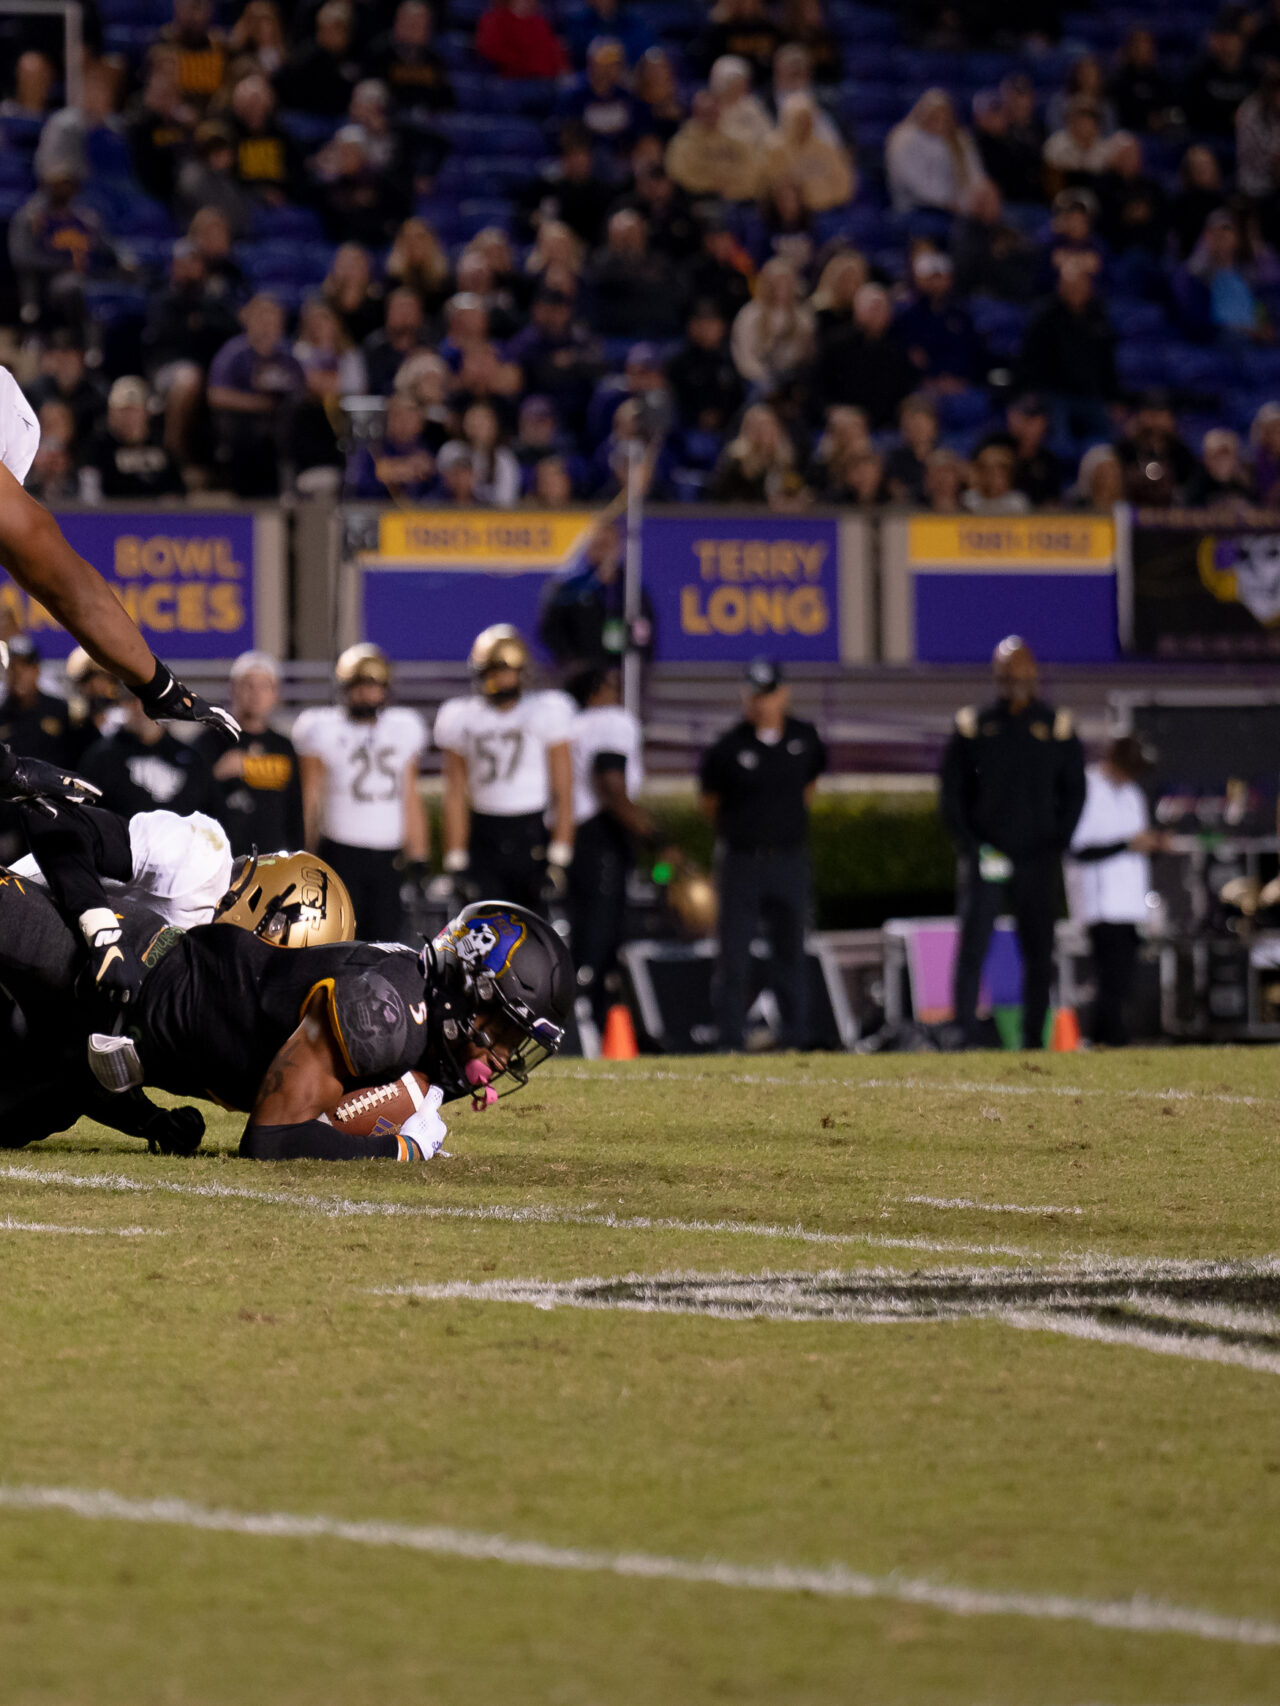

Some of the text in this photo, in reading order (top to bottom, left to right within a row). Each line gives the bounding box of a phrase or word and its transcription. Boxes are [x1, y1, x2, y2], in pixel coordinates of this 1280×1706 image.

[113, 535, 243, 579] BOWL
[692, 539, 829, 581] TERRY
[681, 584, 829, 635] LONG
[350, 745, 396, 802] 25
